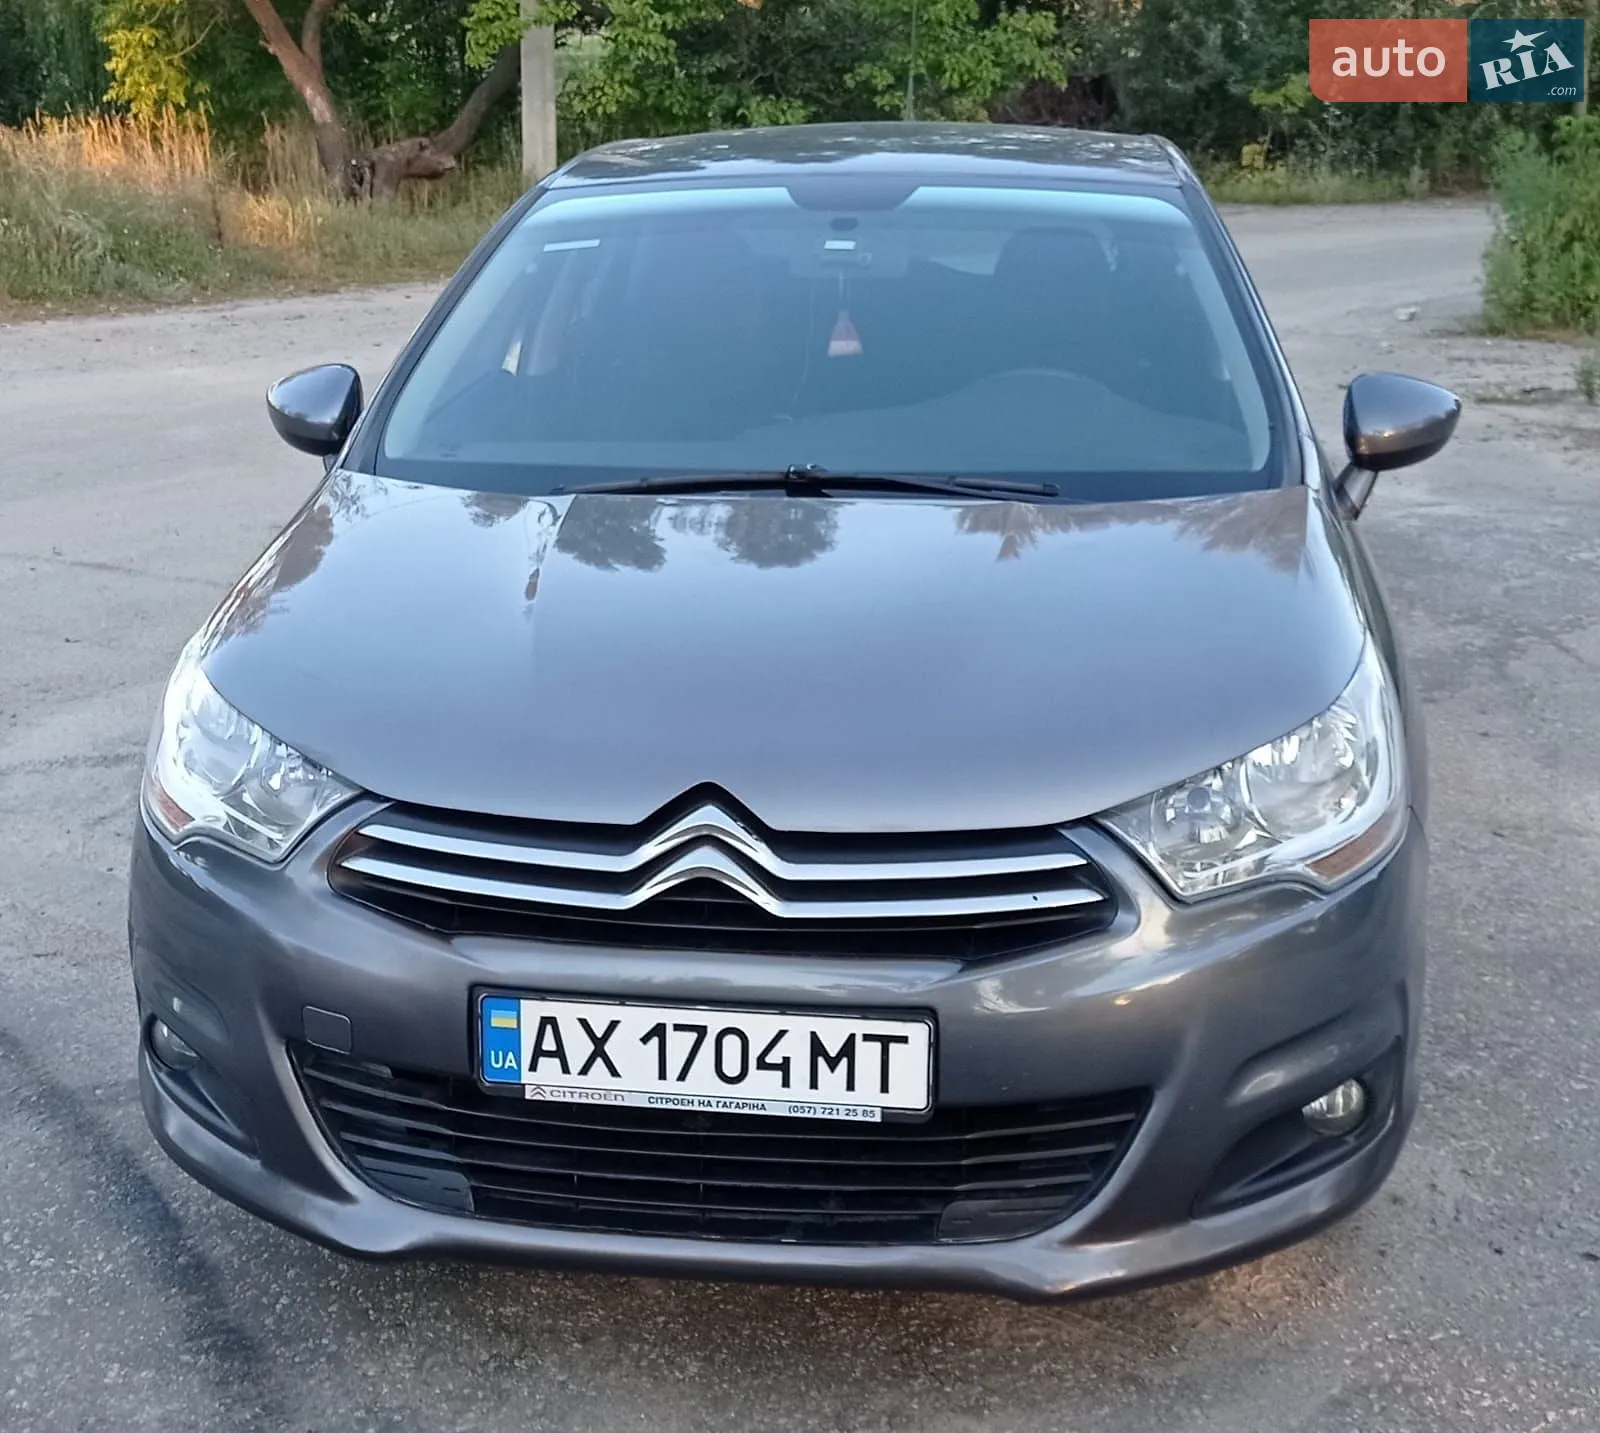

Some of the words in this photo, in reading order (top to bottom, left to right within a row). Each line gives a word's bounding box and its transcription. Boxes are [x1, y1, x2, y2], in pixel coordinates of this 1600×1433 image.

[490, 1049, 518, 1071] UA
[528, 1015, 623, 1078] AX
[638, 1022, 791, 1089] 1704
[697, 1099, 713, 1109] НА
[715, 1100, 767, 1112] ГАГАРІНА
[787, 1104, 817, 1116] (057)
[820, 1106, 840, 1116] 721
[844, 1108, 859, 1117] 25
[862, 1109, 876, 1118] 85
